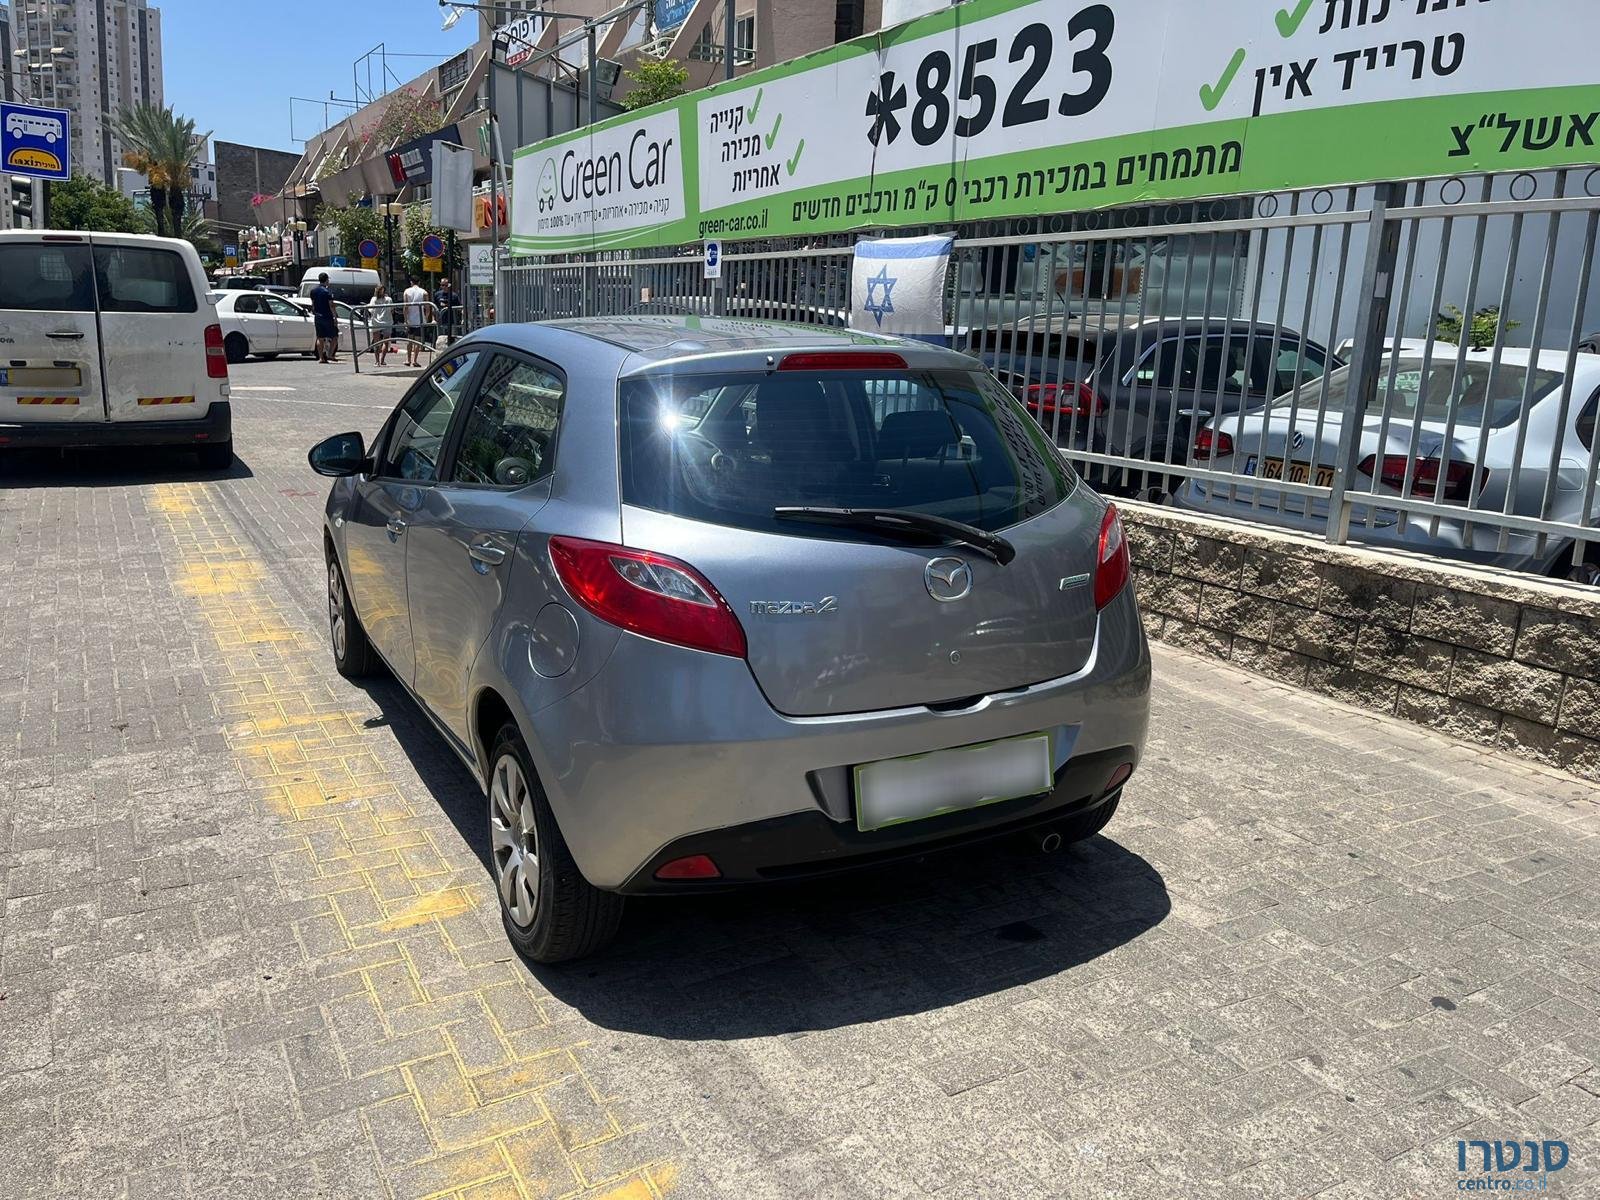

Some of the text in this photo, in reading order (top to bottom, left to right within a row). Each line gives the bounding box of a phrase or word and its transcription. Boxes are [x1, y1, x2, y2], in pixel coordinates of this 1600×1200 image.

[510, 15, 537, 45] דפוס
[1252, 32, 1466, 118] טרייד אין
[710, 105, 744, 134] קנייה
[721, 134, 761, 162] מכירה
[560, 128, 673, 203] Green Car
[732, 163, 780, 192] אחריות
[1116, 140, 1242, 186] מתמחים
[963, 174, 1009, 204] רכבי
[1013, 160, 1107, 199] במכירת
[628, 201, 649, 216] מכירה
[653, 198, 670, 215] קניה
[792, 196, 841, 222] חדשים
[845, 188, 898, 216] ורכבים
[699, 208, 768, 238] green-car.co.il
